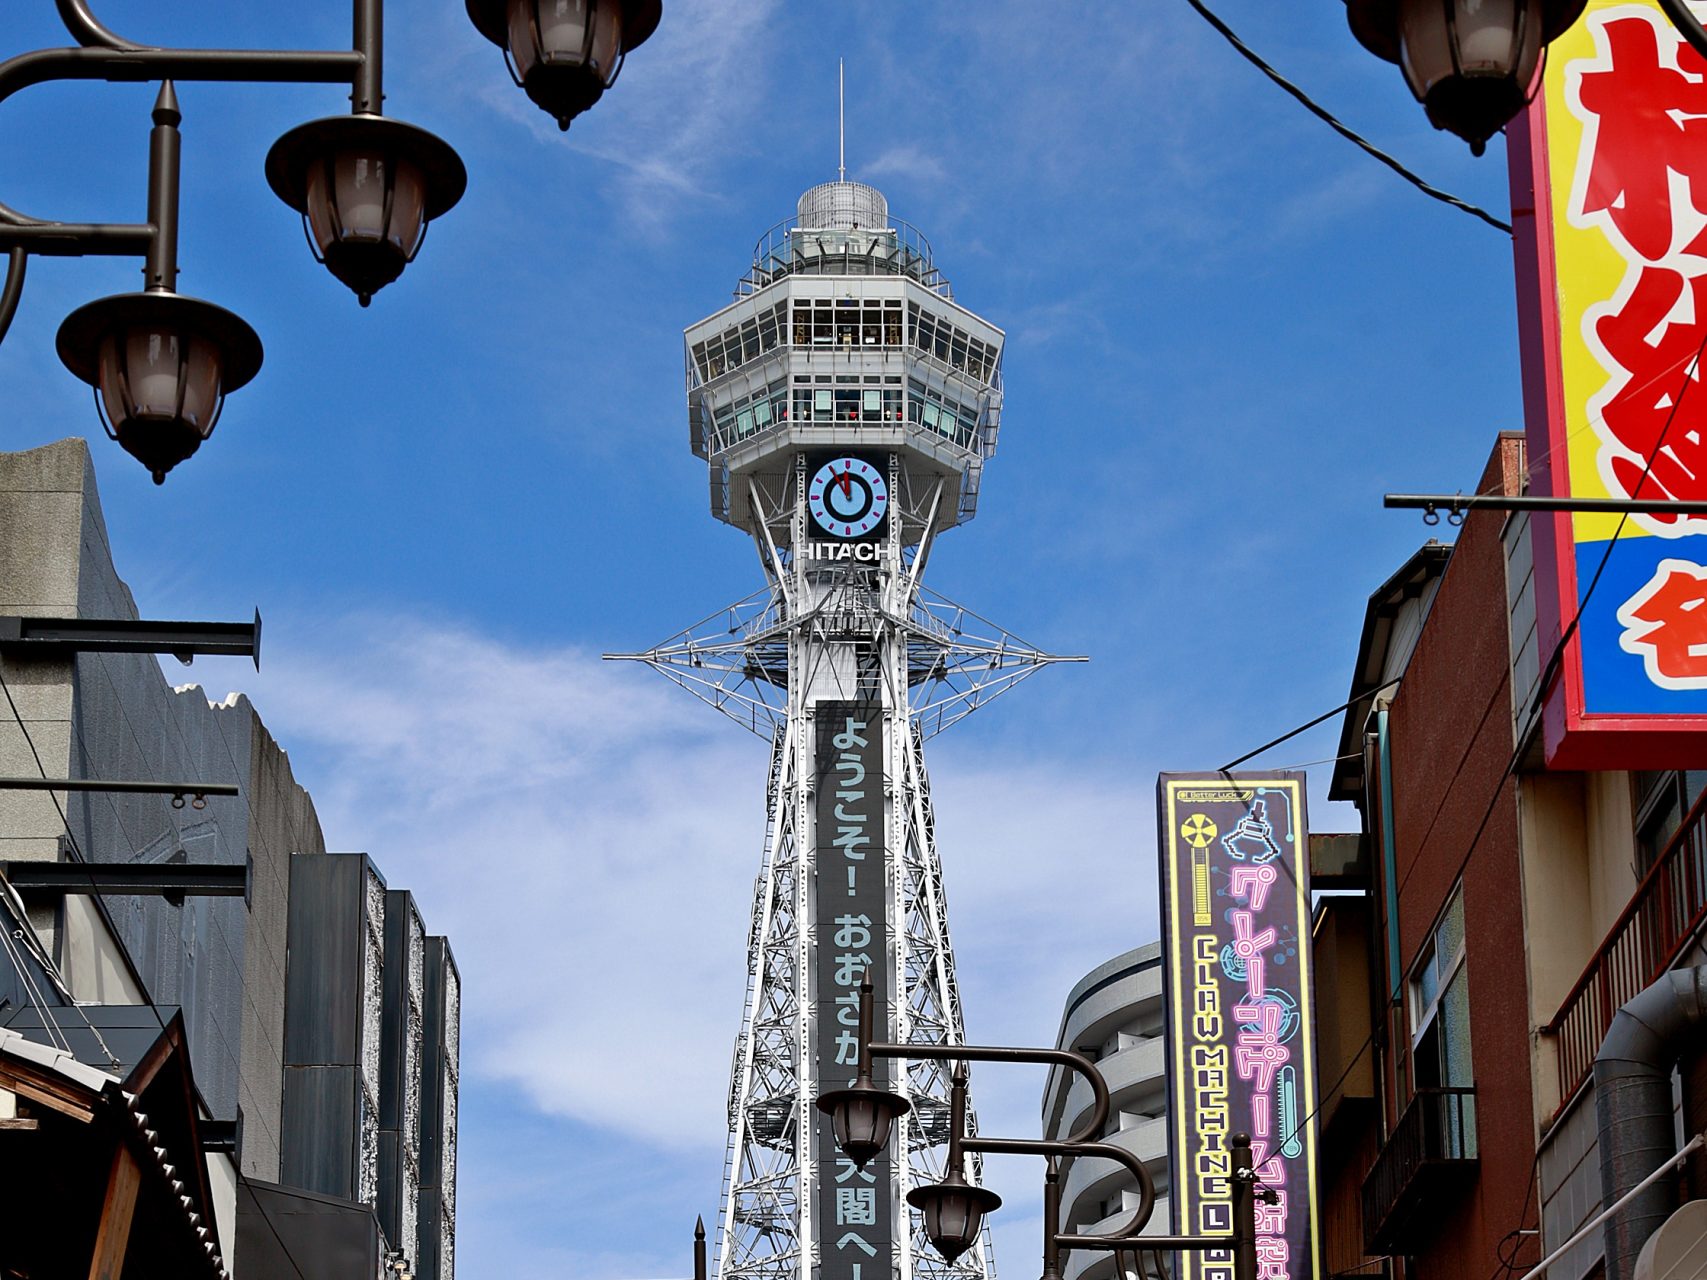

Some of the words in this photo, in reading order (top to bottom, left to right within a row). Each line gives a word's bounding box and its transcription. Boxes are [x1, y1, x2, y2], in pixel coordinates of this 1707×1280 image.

[796, 543, 900, 561] HITACHI
[832, 717, 869, 897] ようこそ！
